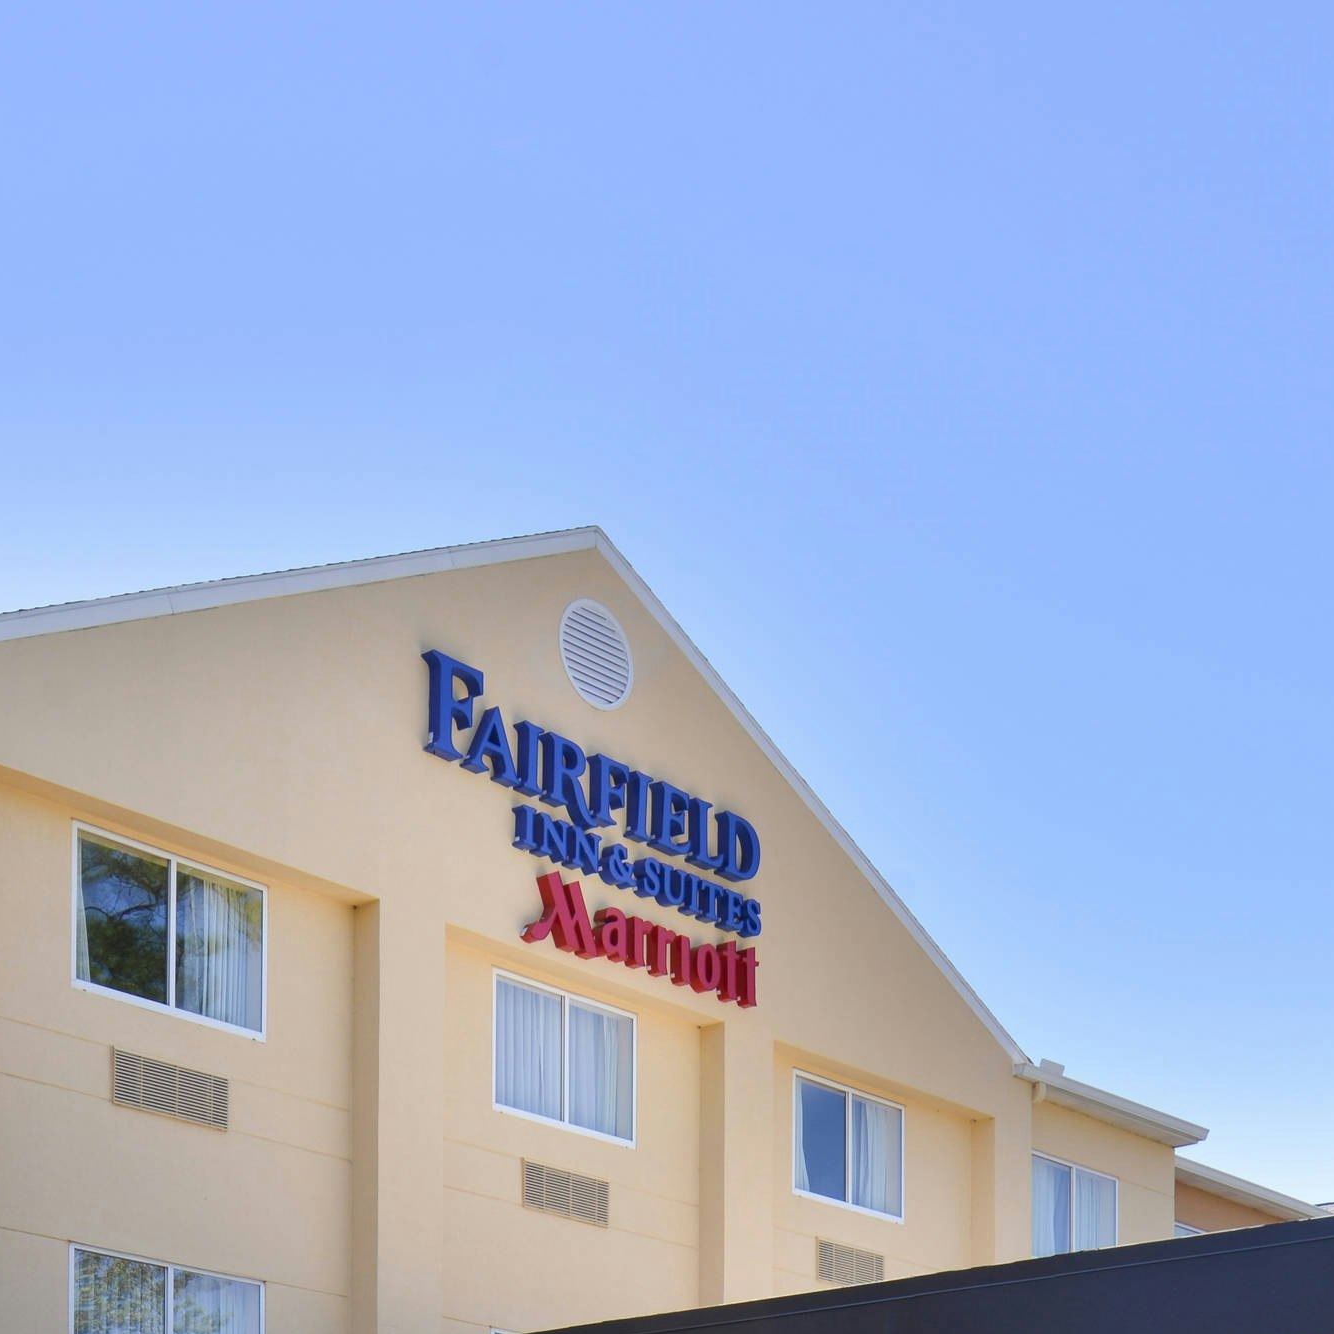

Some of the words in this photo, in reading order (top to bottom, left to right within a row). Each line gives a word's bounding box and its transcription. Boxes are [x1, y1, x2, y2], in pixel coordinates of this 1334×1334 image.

[421, 649, 761, 882] FAIRFIELD
[512, 804, 603, 876] INN
[602, 844, 638, 889] &
[634, 856, 761, 938] SUITES
[520, 871, 759, 1009] Marriott
